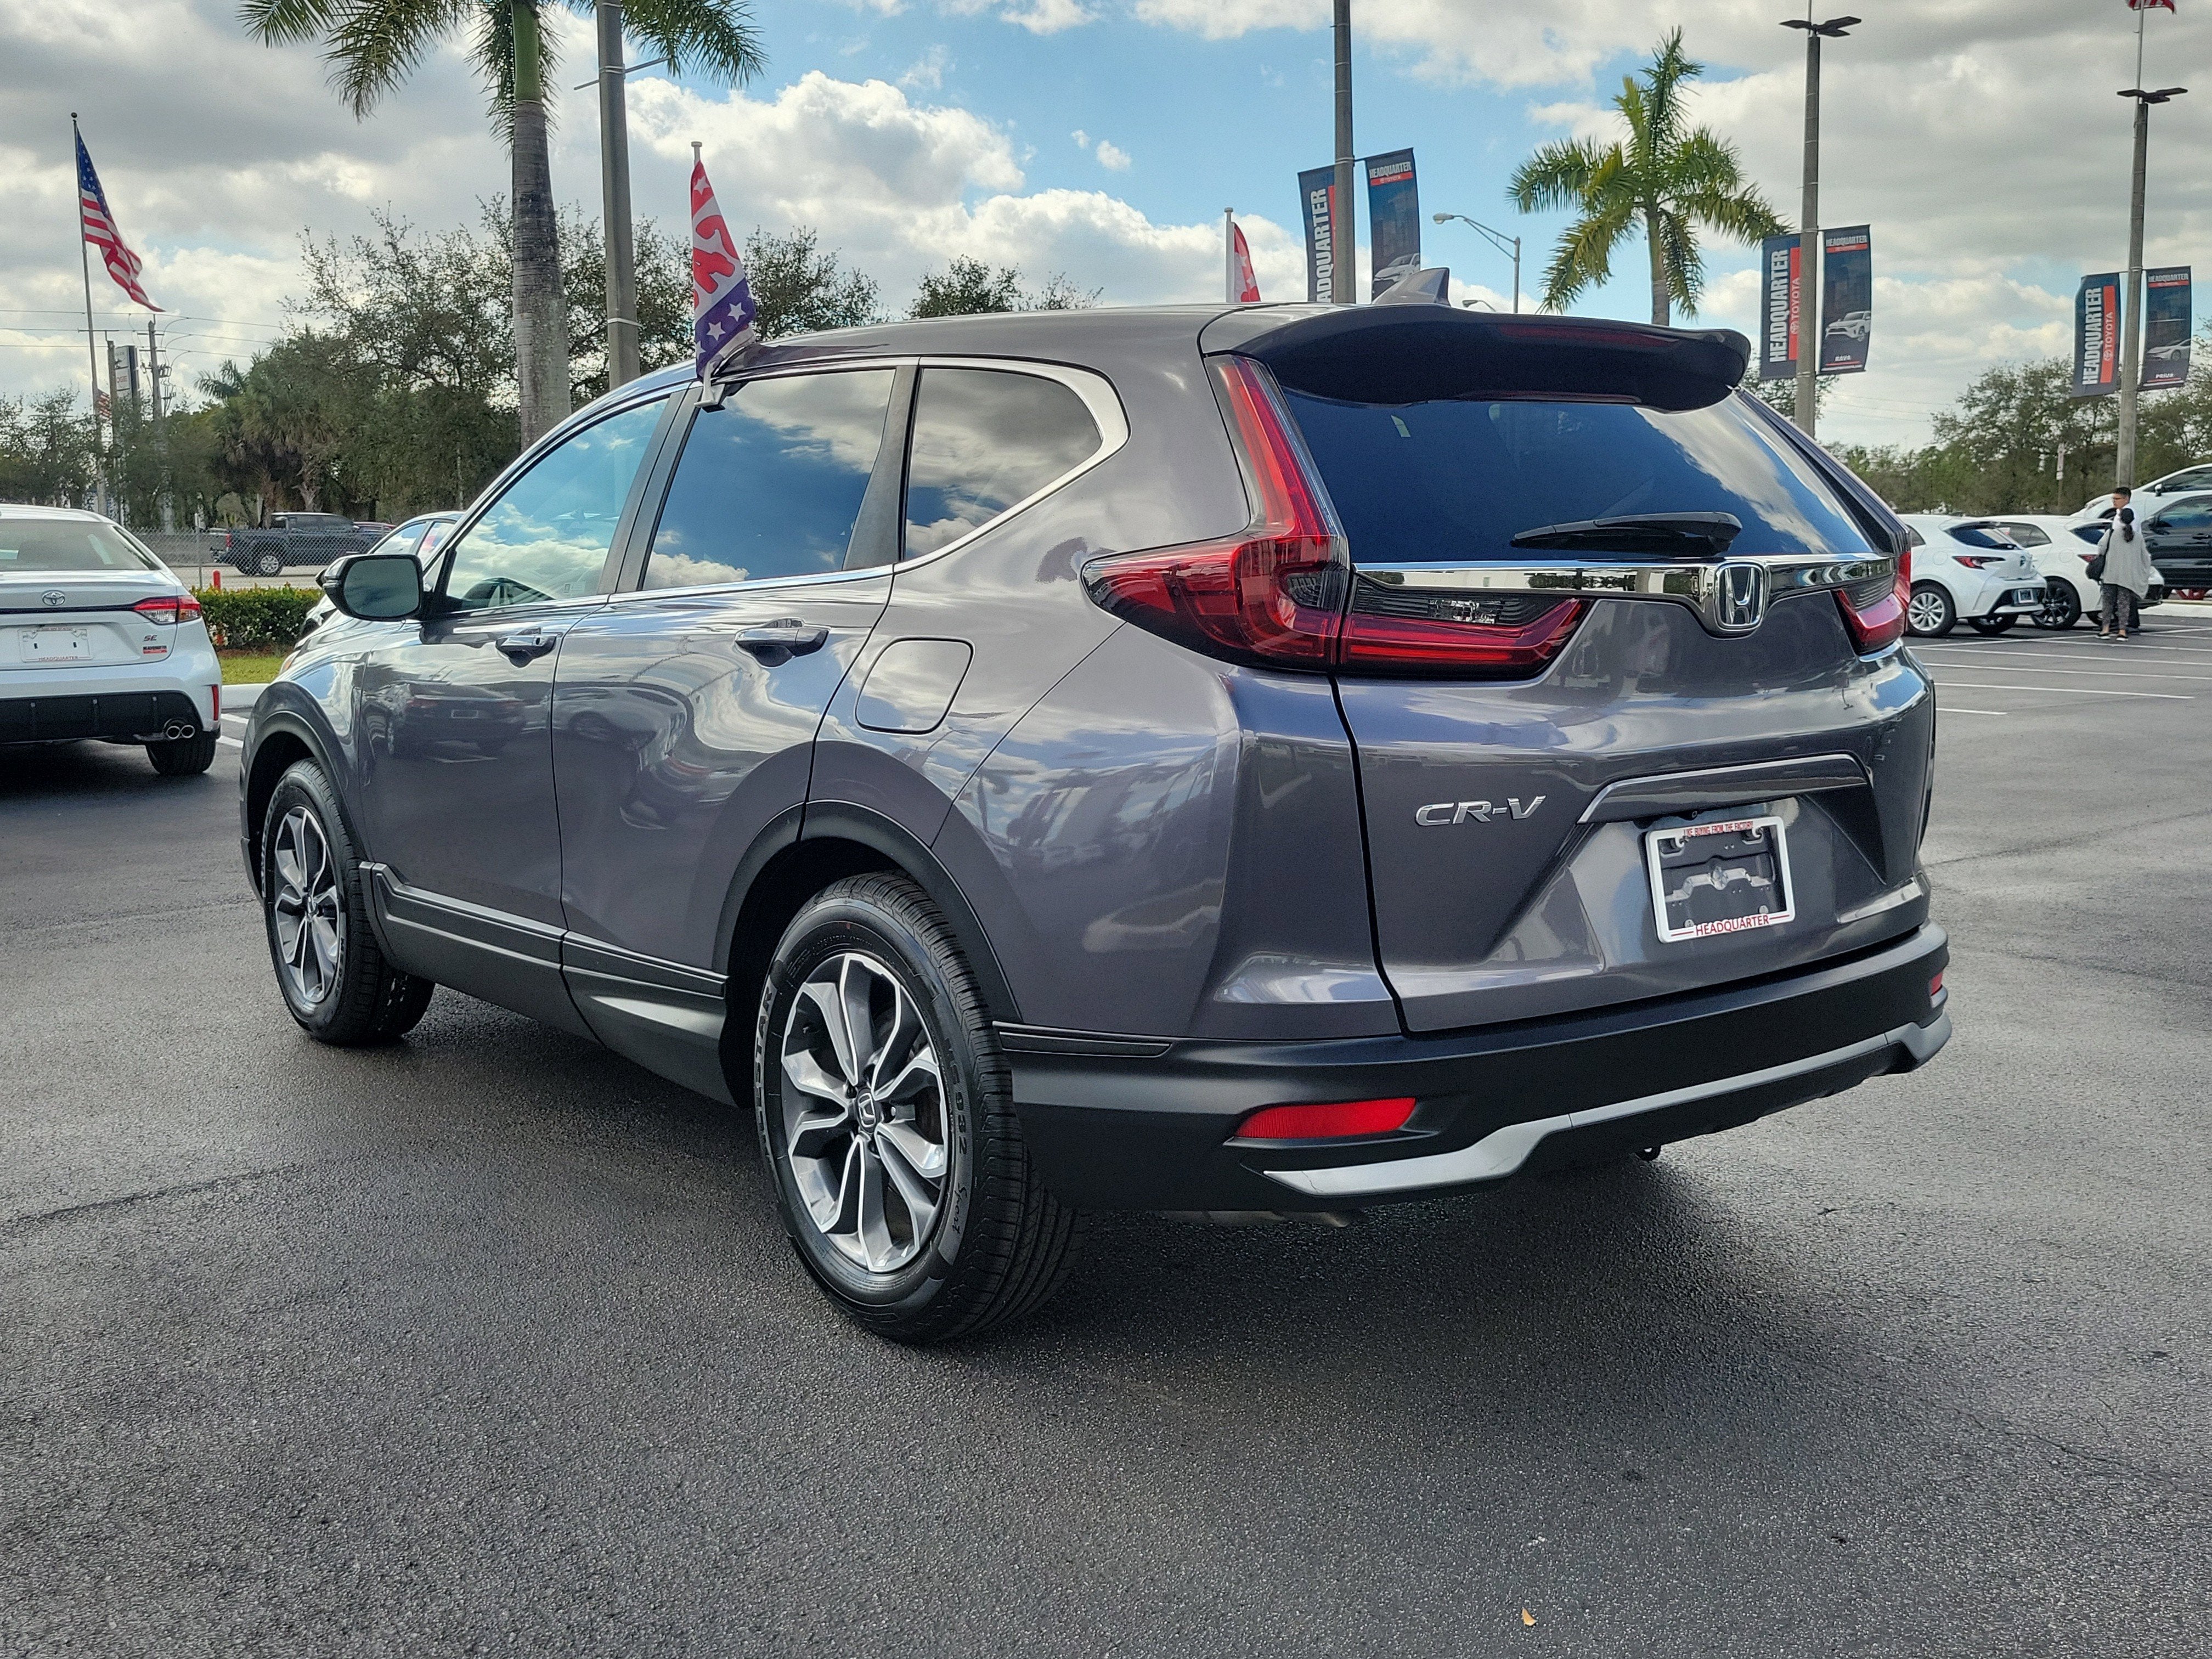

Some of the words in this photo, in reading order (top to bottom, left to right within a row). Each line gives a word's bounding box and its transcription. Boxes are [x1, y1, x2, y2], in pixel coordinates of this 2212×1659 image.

[1369, 161, 1412, 179] HEADQUARTER
[1310, 188, 1334, 303] ADQUARTER
[1769, 249, 1790, 362] HEADQUARTER
[1791, 276, 1801, 320] TOYOTA
[2082, 287, 2103, 385] HEADQUARTER
[2104, 312, 2113, 348] TOYOTA
[1415, 795, 1547, 826] CR-V
[1696, 915, 1769, 936] HEADQUARTER
